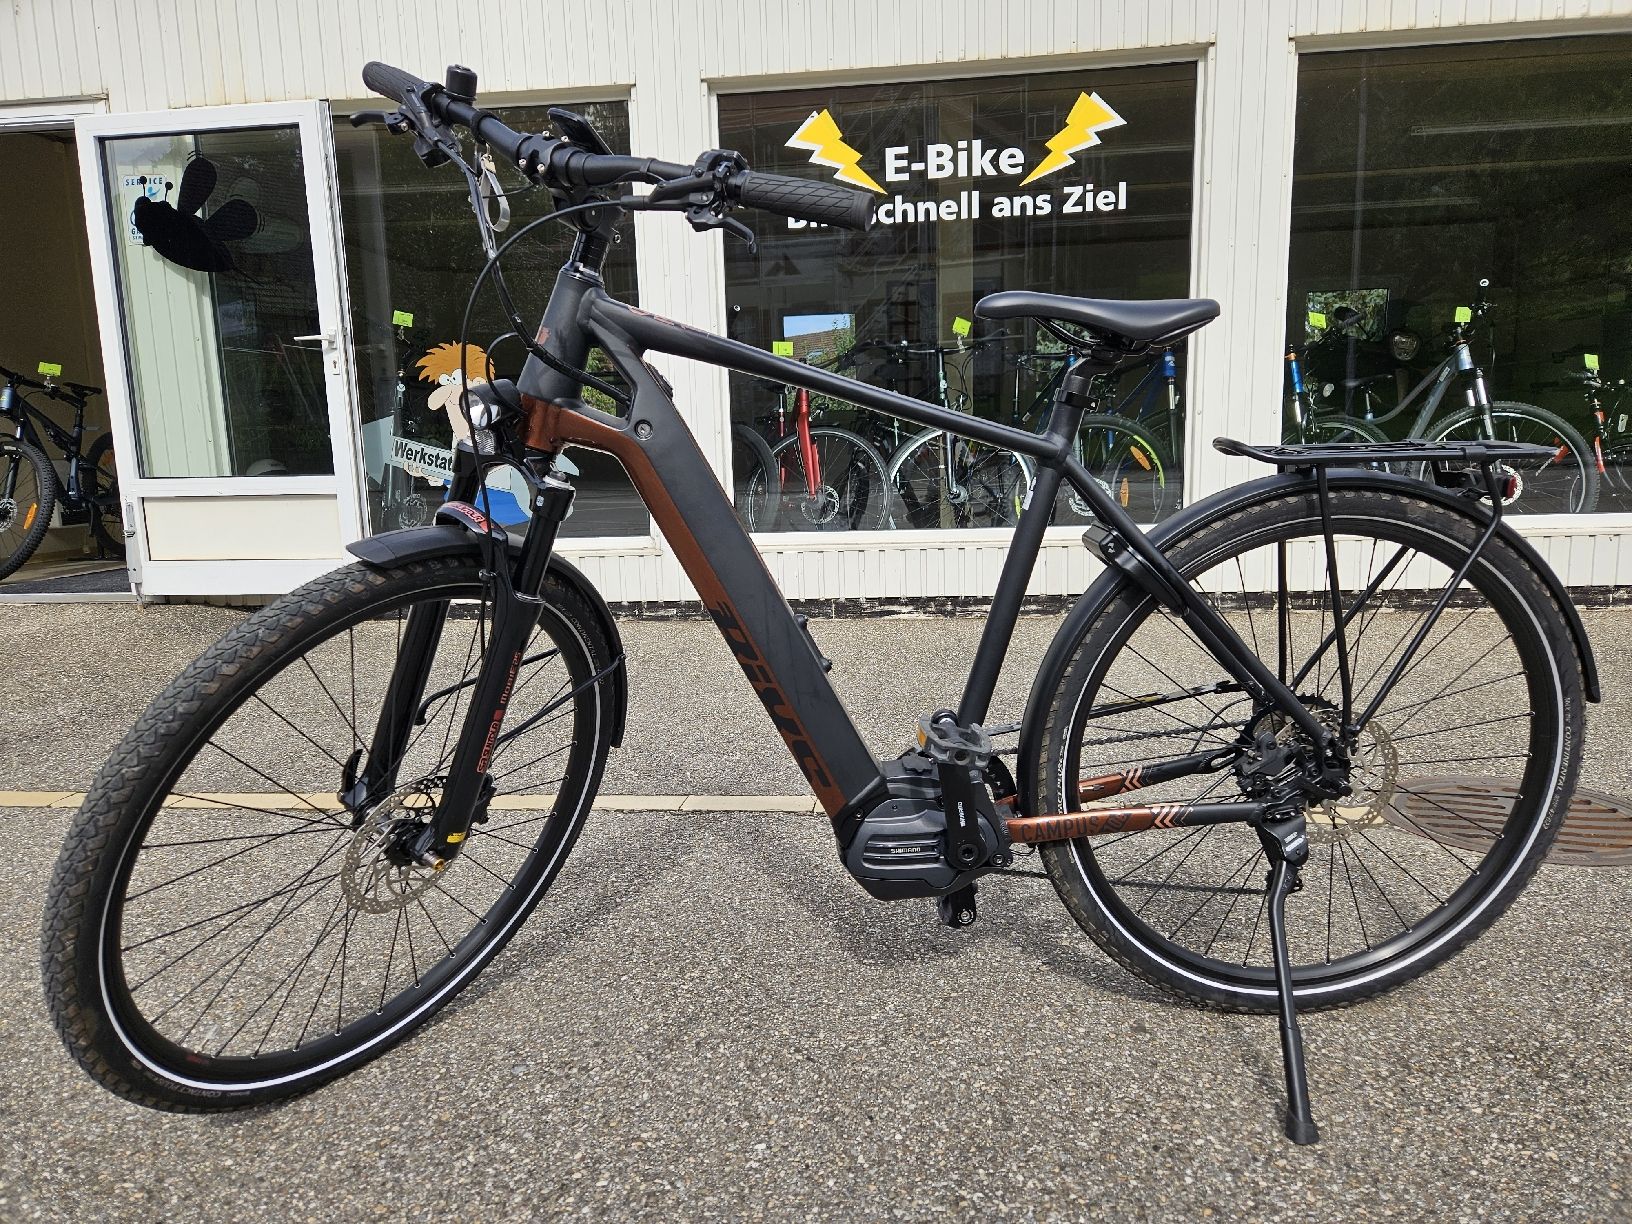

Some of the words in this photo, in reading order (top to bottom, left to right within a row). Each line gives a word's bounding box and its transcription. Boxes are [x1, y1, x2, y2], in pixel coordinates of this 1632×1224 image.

[885, 139, 1025, 182] E-Bike
[125, 177, 163, 186] SERICE
[992, 193, 1052, 218] ans
[1062, 181, 1127, 214] Ziel
[394, 439, 453, 472] Werkstat
[1556, 726, 1572, 791] CONTINENTAL
[1019, 815, 1099, 842] CAMPUS
